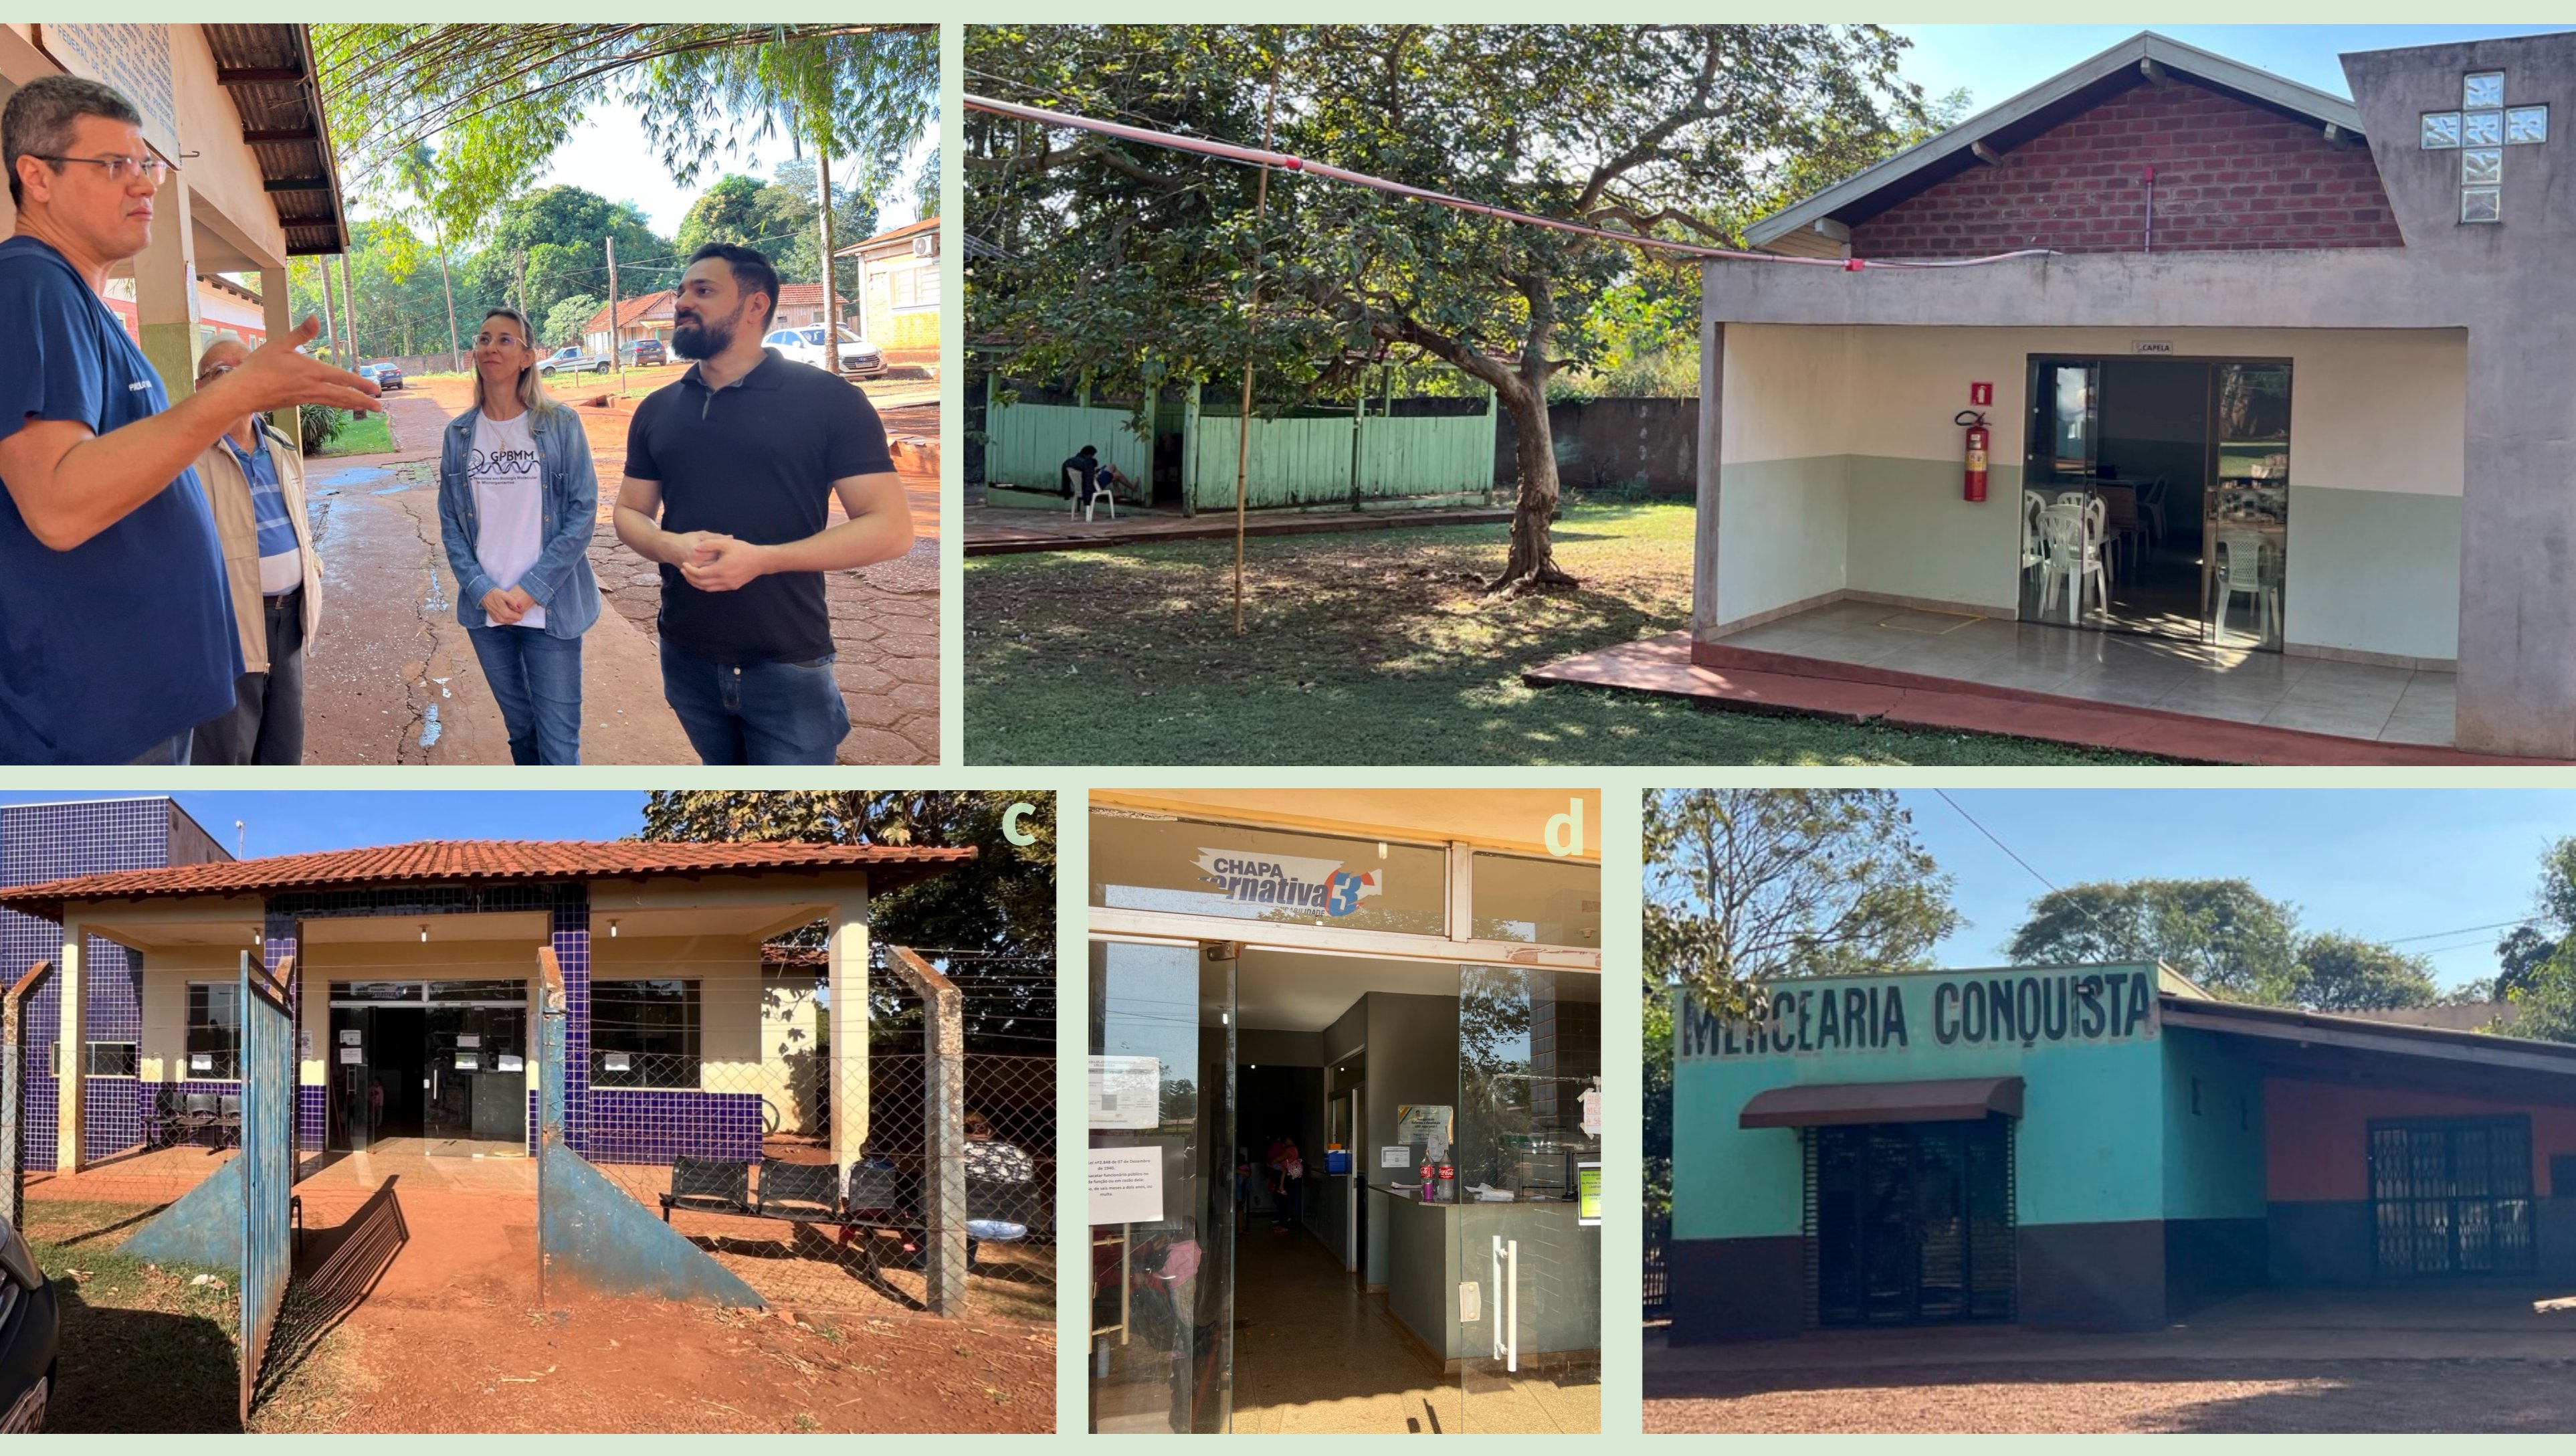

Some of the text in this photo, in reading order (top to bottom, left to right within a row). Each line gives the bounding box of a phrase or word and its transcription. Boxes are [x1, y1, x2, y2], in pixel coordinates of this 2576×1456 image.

[58, 23, 90, 64] FEDERAL
[91, 58, 100, 74] DE
[2143, 344, 2169, 352] CAPELA
[490, 450, 534, 462] GPBMM
[1213, 858, 1284, 879] CHAPA
[1204, 871, 1365, 917] ernativa 3
[1939, 972, 2153, 1048] CONQUISTA
